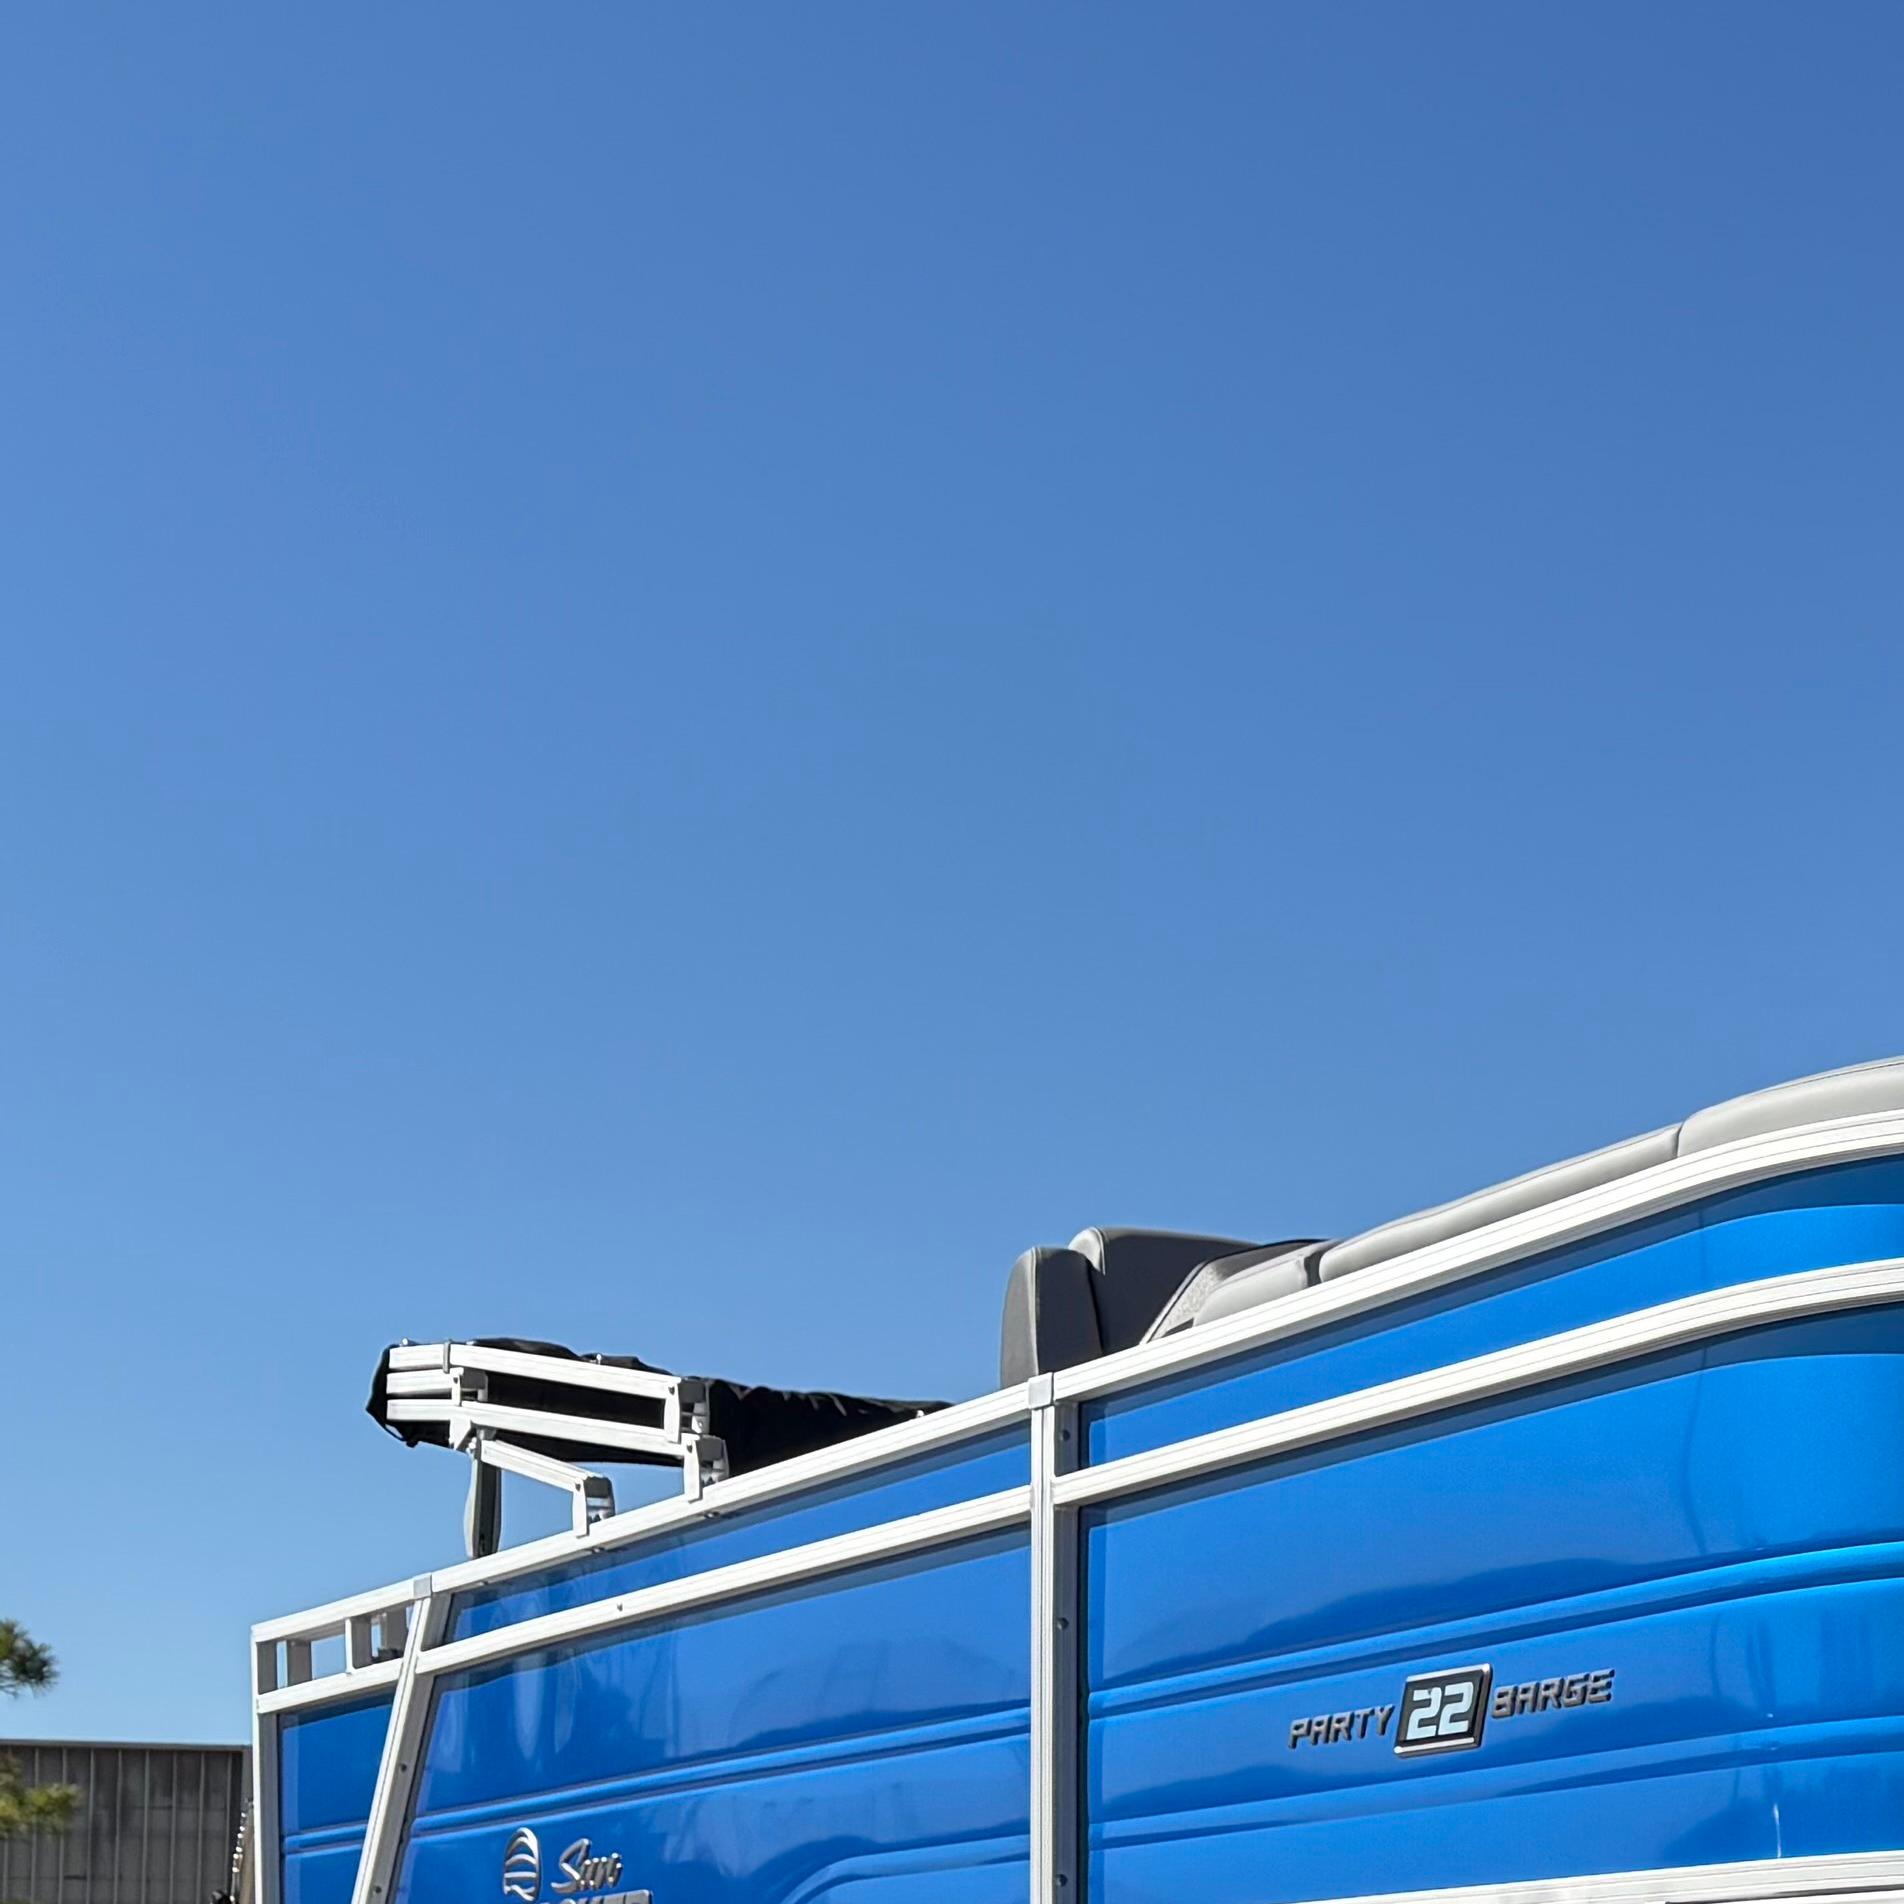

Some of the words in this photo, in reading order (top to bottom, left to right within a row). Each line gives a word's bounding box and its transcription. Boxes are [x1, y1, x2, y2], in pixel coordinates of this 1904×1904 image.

[1287, 1704, 1394, 1749] PARTY
[1406, 1681, 1474, 1740] 22
[1491, 1669, 1615, 1719] BARGE
[551, 1838, 624, 1894] Sun
